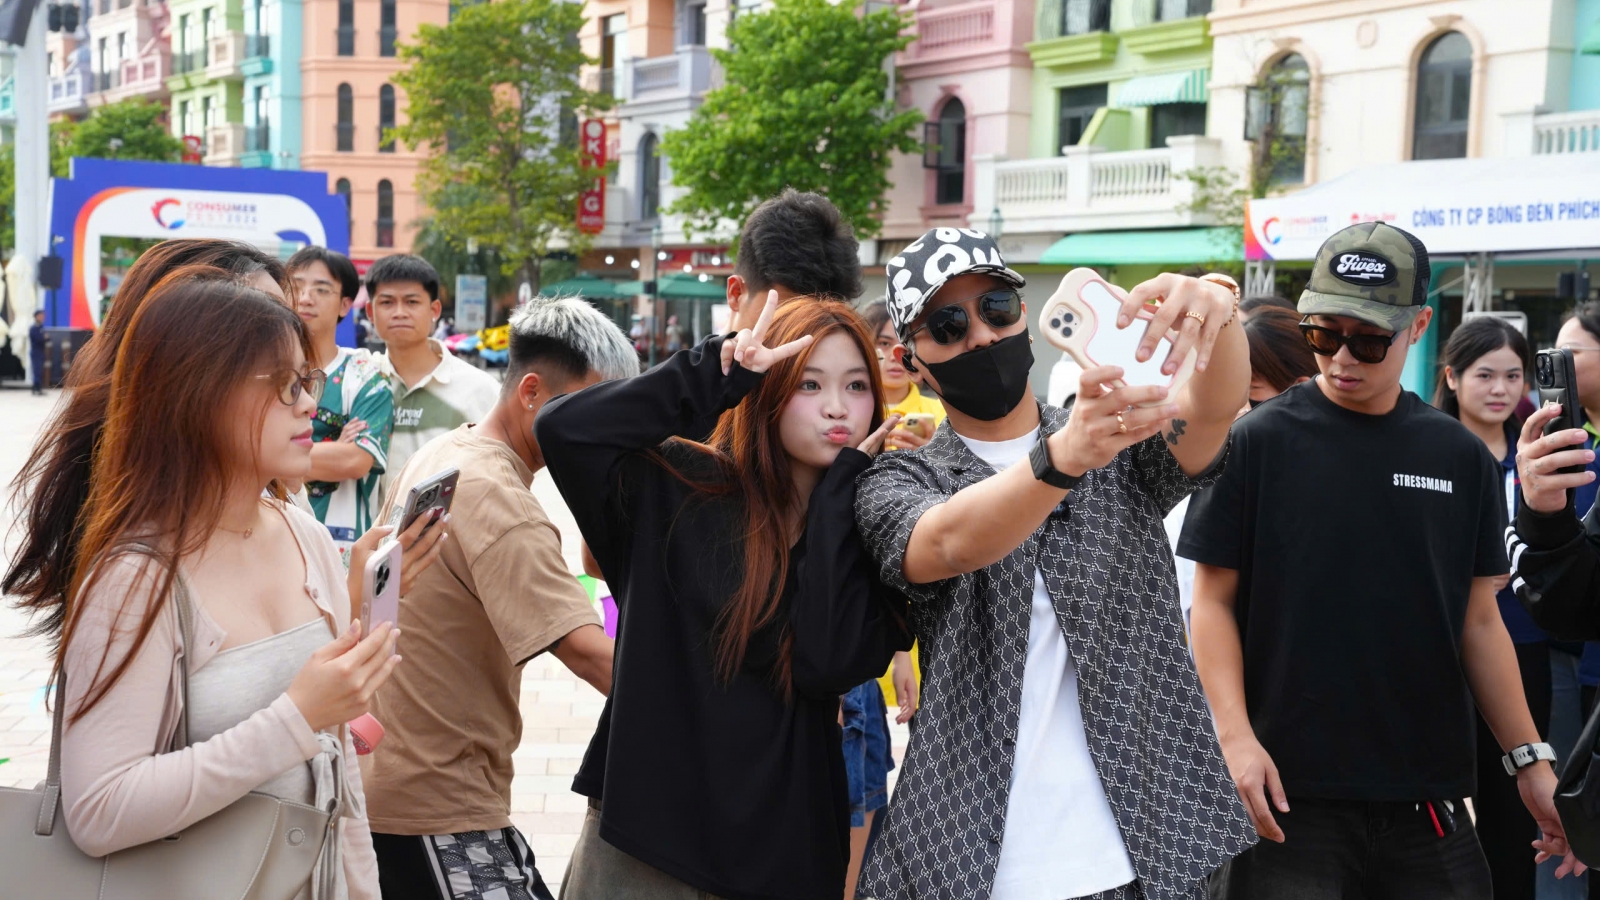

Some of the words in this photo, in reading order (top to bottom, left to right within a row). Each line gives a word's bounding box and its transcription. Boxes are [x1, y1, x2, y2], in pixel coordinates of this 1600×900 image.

[1412, 205, 1445, 227] CÔNG
[1450, 208, 1462, 226] TY
[1467, 206, 1483, 225] CP
[1337, 254, 1386, 274] Fivex
[1393, 473, 1453, 494] STRESSMAMA
